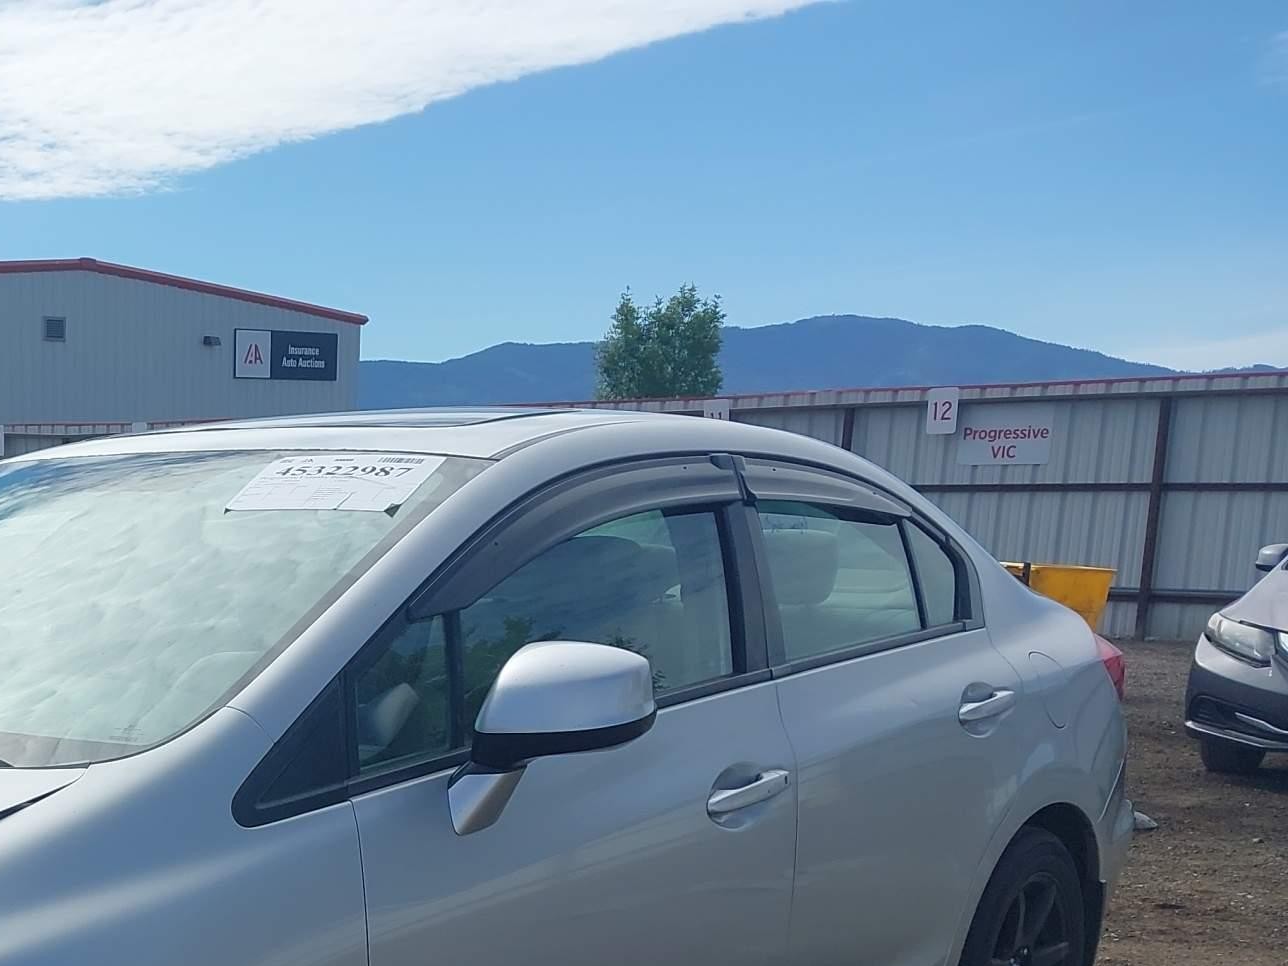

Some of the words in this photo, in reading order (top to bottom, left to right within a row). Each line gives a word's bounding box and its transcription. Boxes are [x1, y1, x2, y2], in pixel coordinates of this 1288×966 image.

[288, 344, 320, 355] Insurance
[281, 356, 297, 368] Auto
[298, 357, 325, 369] Auctions
[933, 401, 953, 421] 12
[963, 425, 1050, 442] Progressive
[991, 445, 1017, 459] VIC
[276, 465, 414, 478] 45322987
